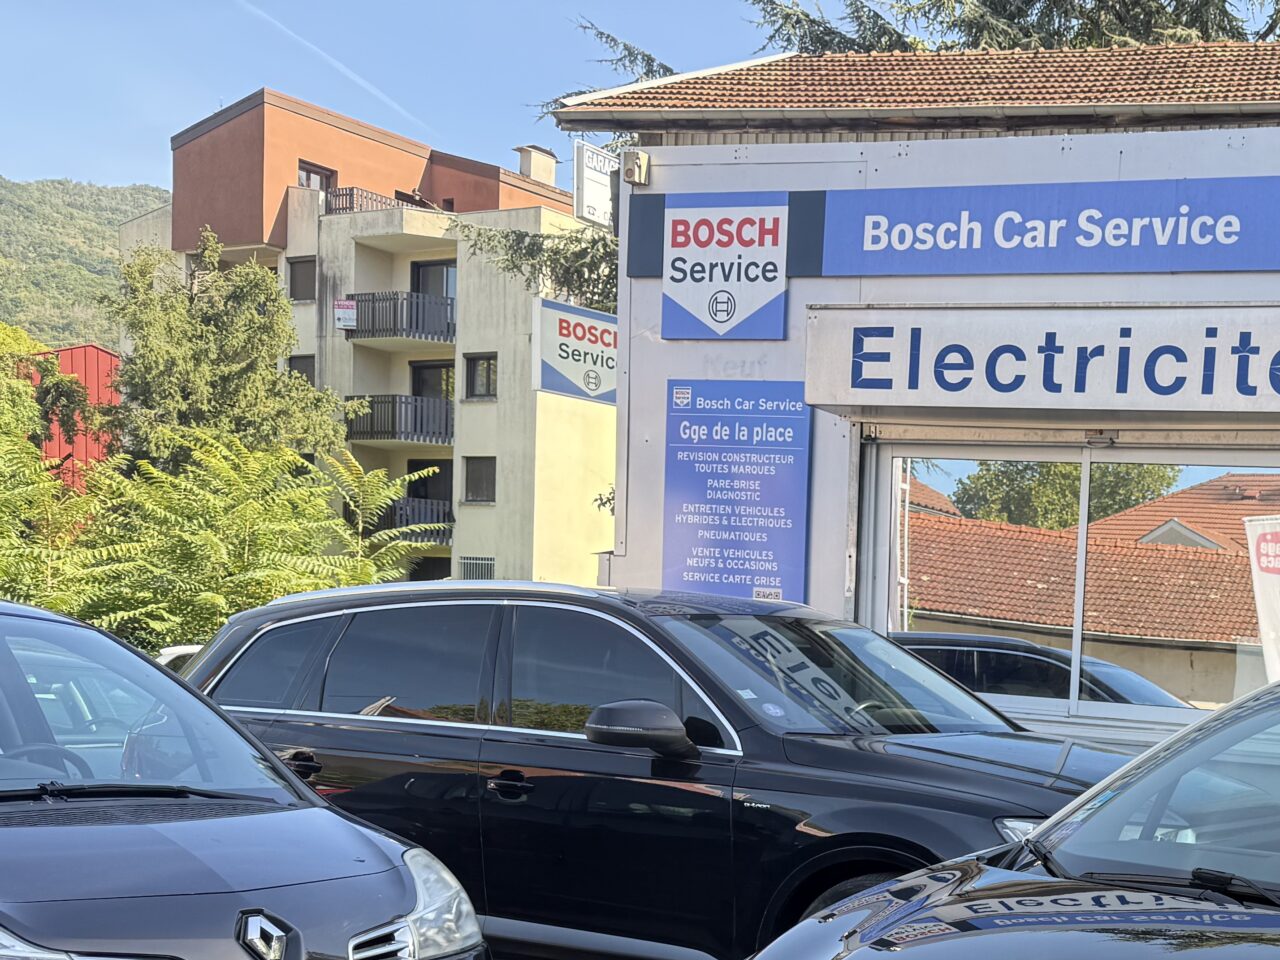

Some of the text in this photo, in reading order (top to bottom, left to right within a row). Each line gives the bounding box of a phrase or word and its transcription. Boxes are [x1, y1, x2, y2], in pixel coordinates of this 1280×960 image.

[670, 217, 780, 249] BOSCH
[862, 204, 1242, 252] Bosch Car Service
[669, 254, 779, 284] Service
[558, 342, 617, 370] Servic
[696, 397, 803, 411] Bosch Car Service
[680, 420, 794, 445] Gge de la place
[677, 451, 794, 464] REVISION CONSTRUCTEUR
[694, 463, 776, 475] TOUTES MARQUES
[707, 479, 761, 489] PARE-BRISE
[706, 490, 761, 501] DIAGNOSTIC
[683, 503, 785, 516] ENTRETIEN VEHICULES
[675, 514, 793, 528] HYBRIDES & ELECTRIQUES
[698, 530, 768, 542] PNEUMATIQUES
[692, 547, 774, 560] VENTE VEHICULES
[686, 557, 778, 571] NEUFS & OCCASIONS
[683, 571, 782, 586] SERVICE CARTE GRISE
